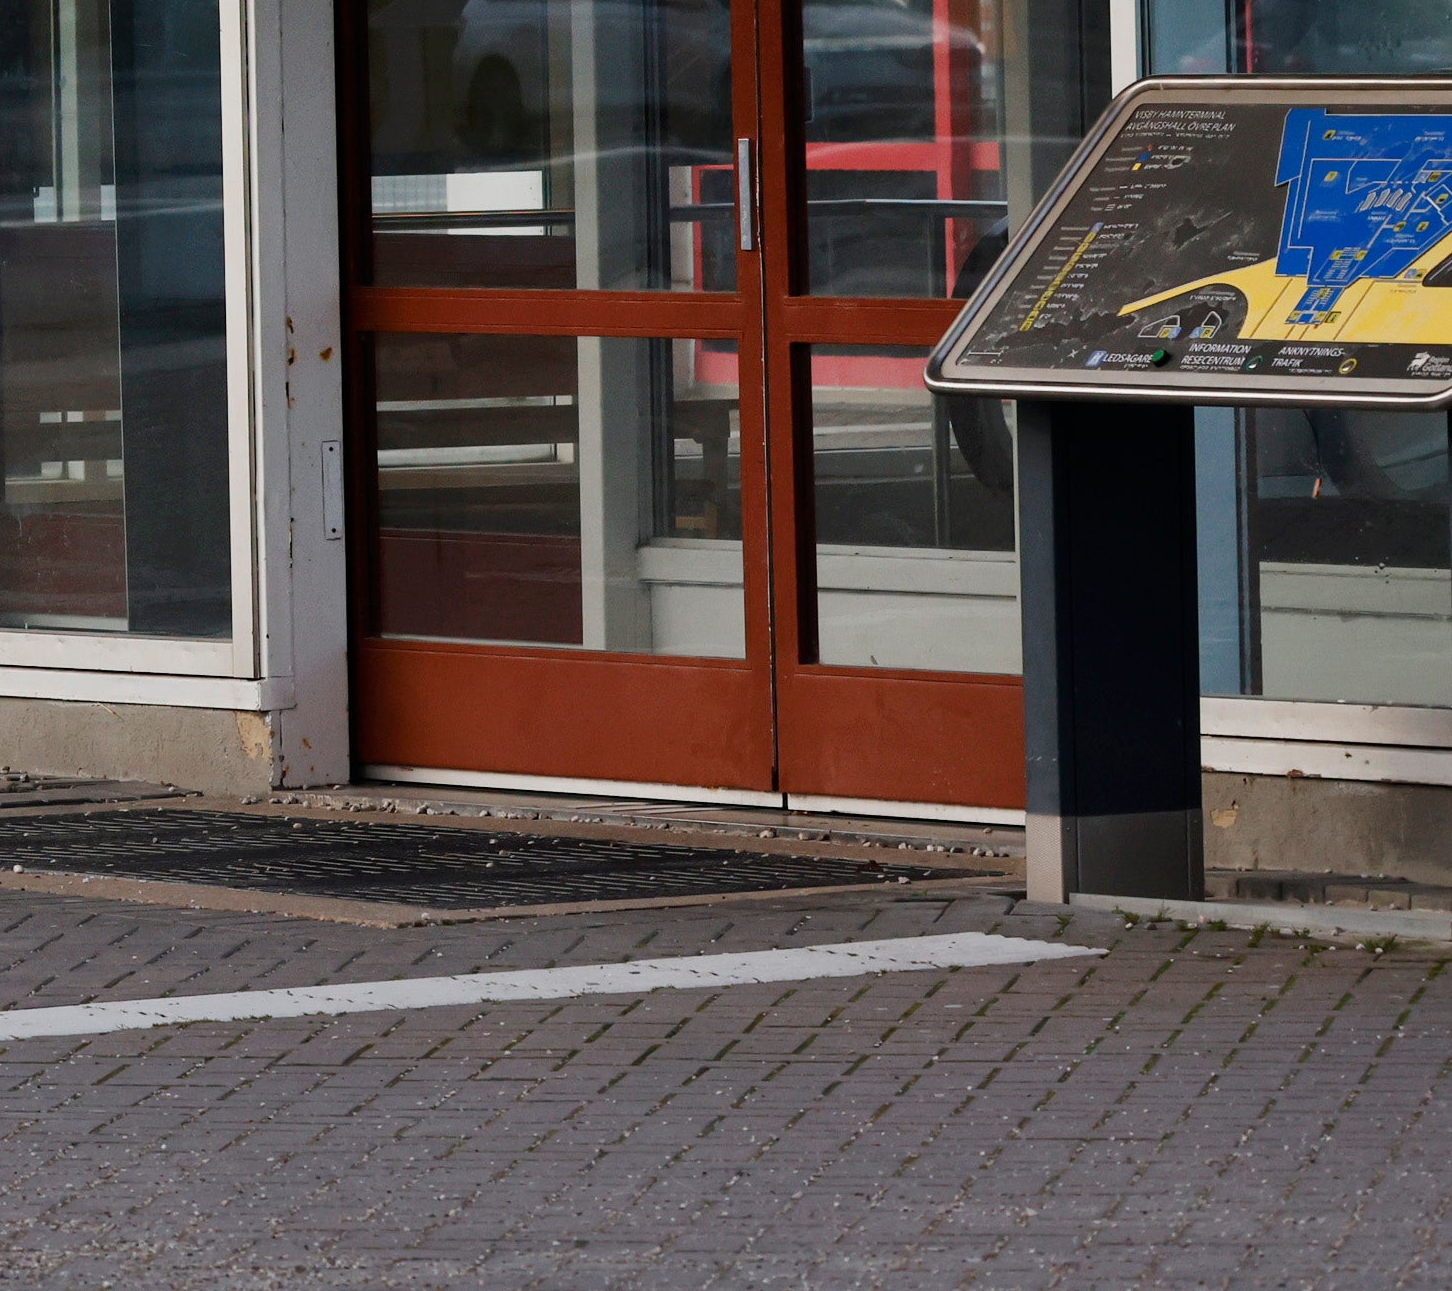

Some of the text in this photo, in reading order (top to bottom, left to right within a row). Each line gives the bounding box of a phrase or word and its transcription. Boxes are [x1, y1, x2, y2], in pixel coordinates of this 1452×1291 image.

[1135, 110, 1227, 120] VISBY HAMNTERMINAL
[1125, 121, 1189, 131] AVGÅNGSHALL
[1209, 123, 1237, 132] PLAN
[1188, 343, 1252, 354] INFORMATION
[1180, 354, 1246, 365] RESECENTRUM
[1271, 357, 1304, 368] TRAFIK
